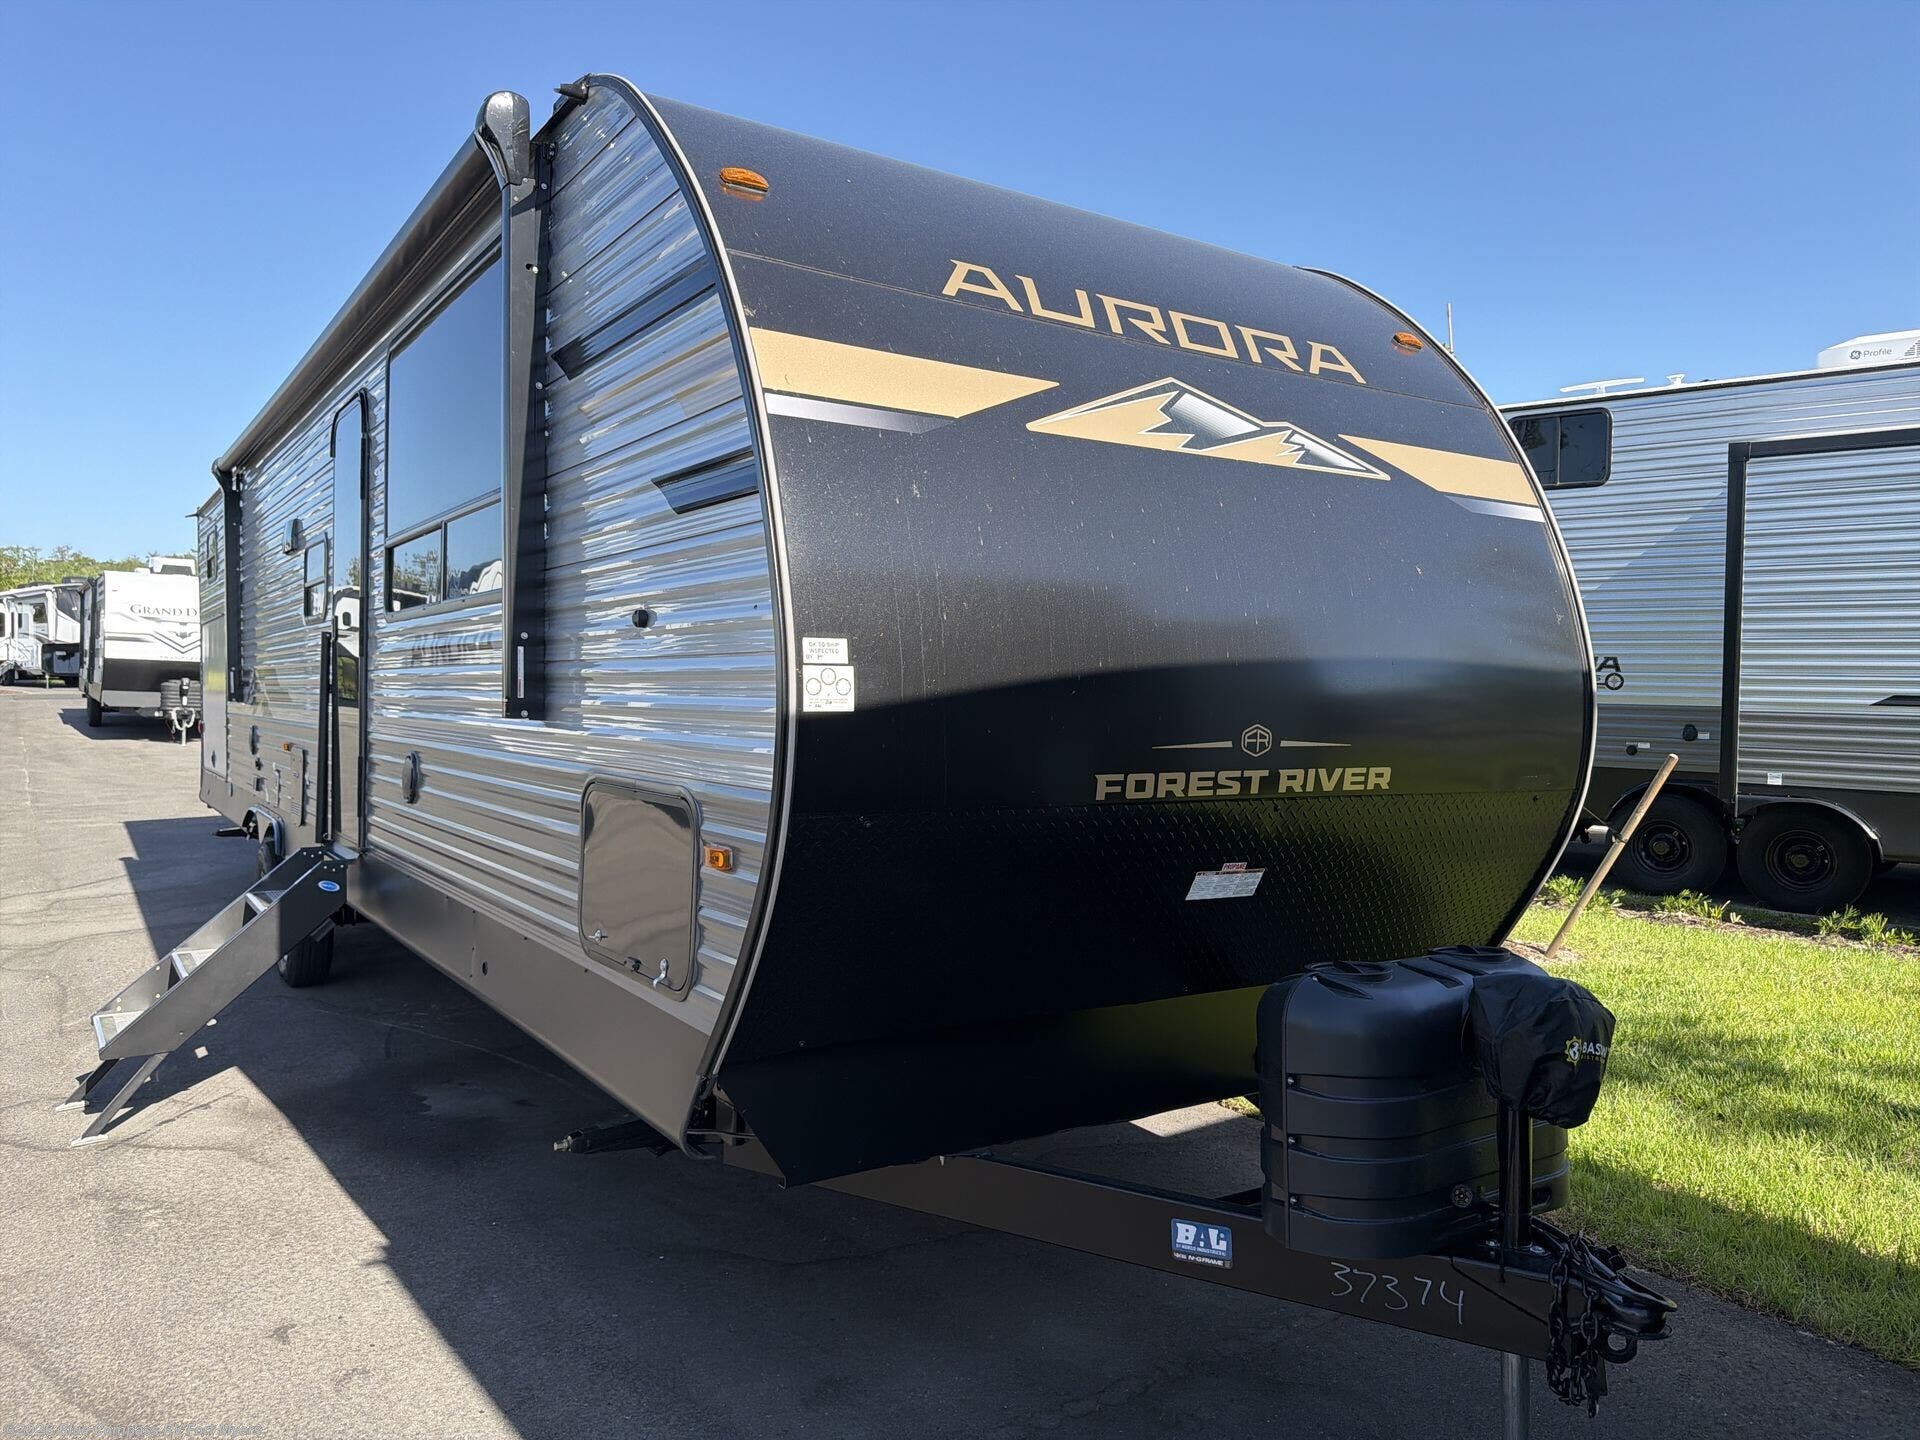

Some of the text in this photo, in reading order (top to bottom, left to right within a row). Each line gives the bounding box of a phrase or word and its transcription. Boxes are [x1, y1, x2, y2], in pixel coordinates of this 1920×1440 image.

[942, 259, 1366, 384] AURORA
[1863, 348, 1892, 358] Profile
[130, 604, 183, 615] GRAND
[1095, 767, 1391, 800] FOREST RIVER
[1176, 1223, 1227, 1251] BAL
[1331, 1262, 1463, 1325] 37374
